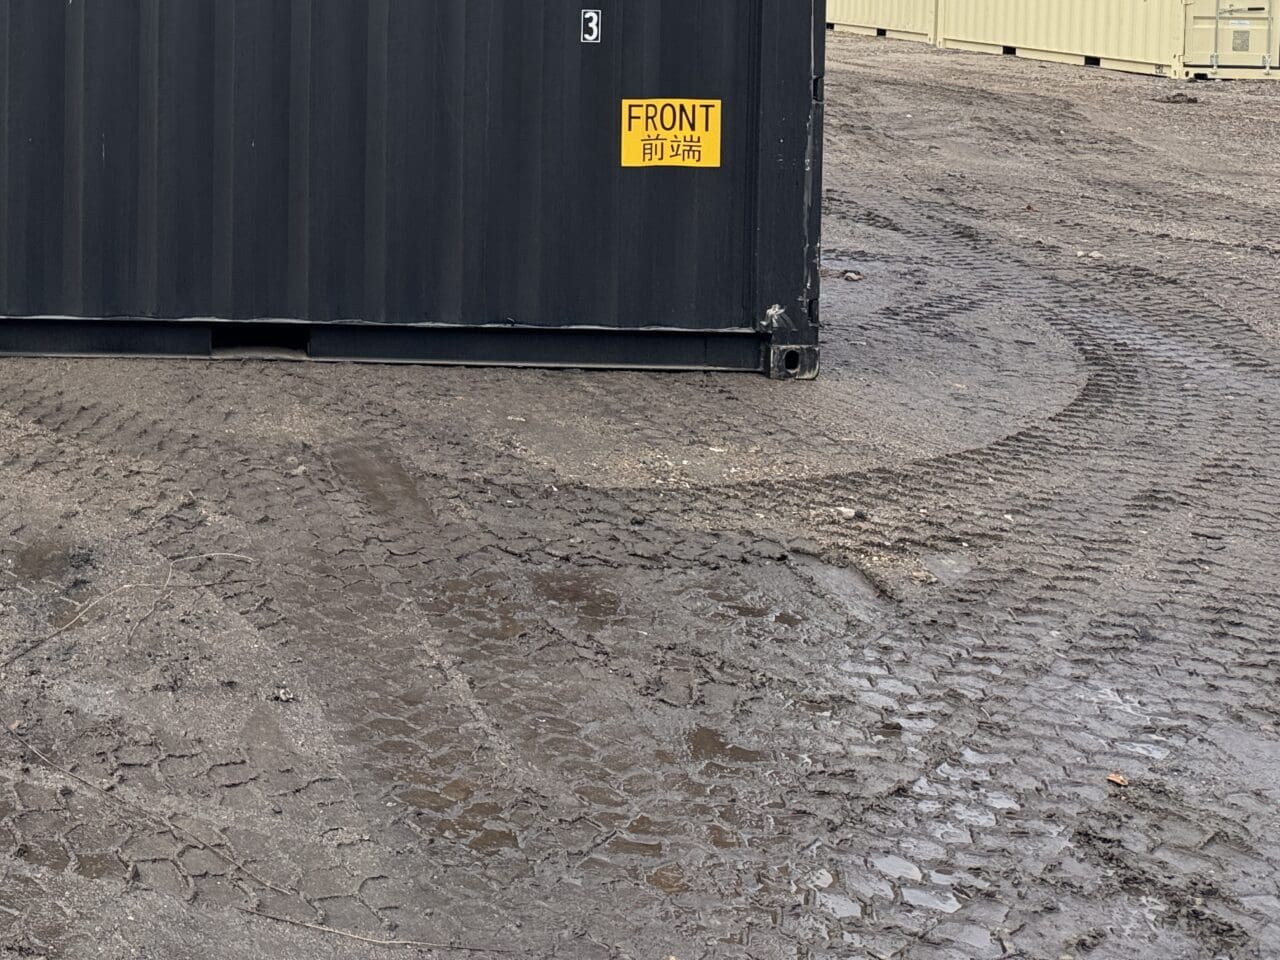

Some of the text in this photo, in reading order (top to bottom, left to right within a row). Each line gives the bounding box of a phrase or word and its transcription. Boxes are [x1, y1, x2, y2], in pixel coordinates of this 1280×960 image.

[583, 12, 599, 39] 3
[627, 103, 716, 132] FRONT
[640, 133, 702, 162] 前端
